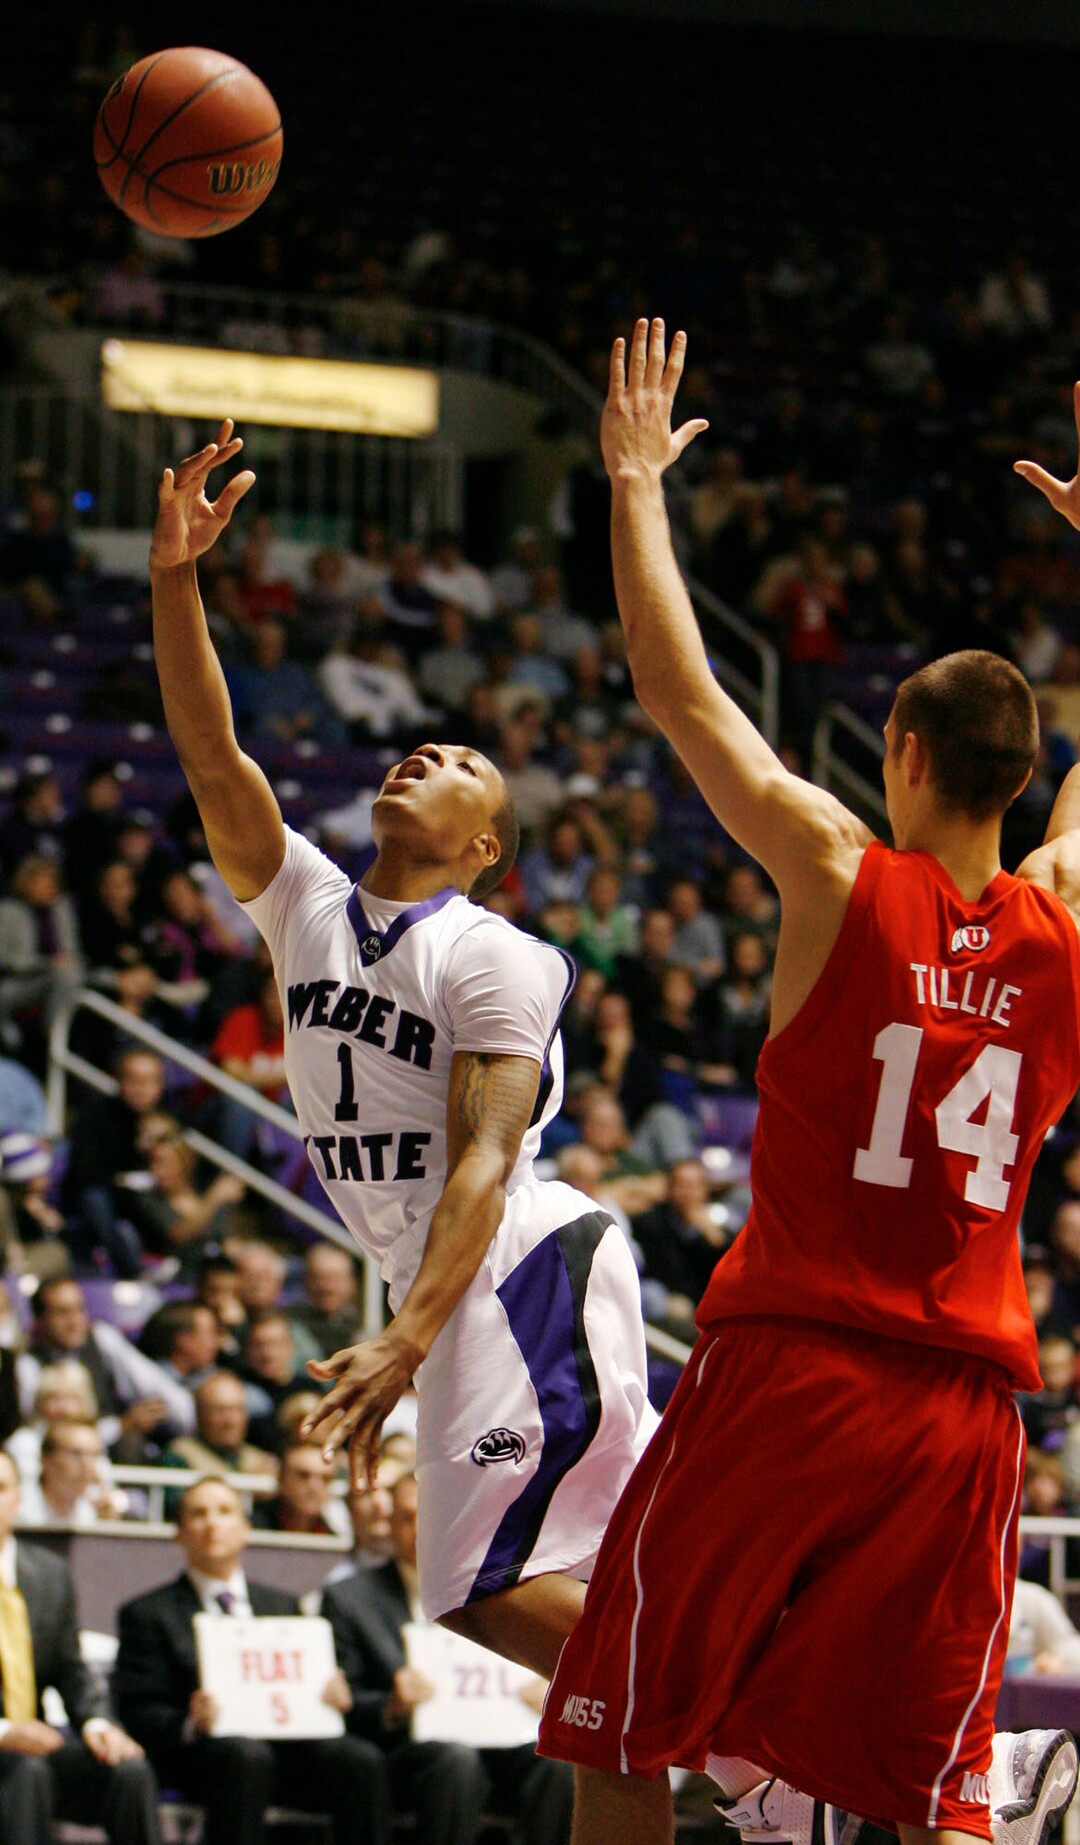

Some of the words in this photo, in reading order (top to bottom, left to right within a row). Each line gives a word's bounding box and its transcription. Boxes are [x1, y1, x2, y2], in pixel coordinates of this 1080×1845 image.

[207, 157, 281, 195] Wils
[966, 929, 984, 947] U
[910, 962, 1022, 1027] TILLIE
[288, 979, 436, 1070] WEBER
[335, 1042, 358, 1121] 1
[853, 1022, 1023, 1212] 14
[241, 1650, 304, 1682] FLAT
[455, 1664, 489, 1697] 22
[271, 1692, 290, 1726] 5
[558, 1694, 606, 1730] MUSS
[960, 1771, 991, 1805] MU
